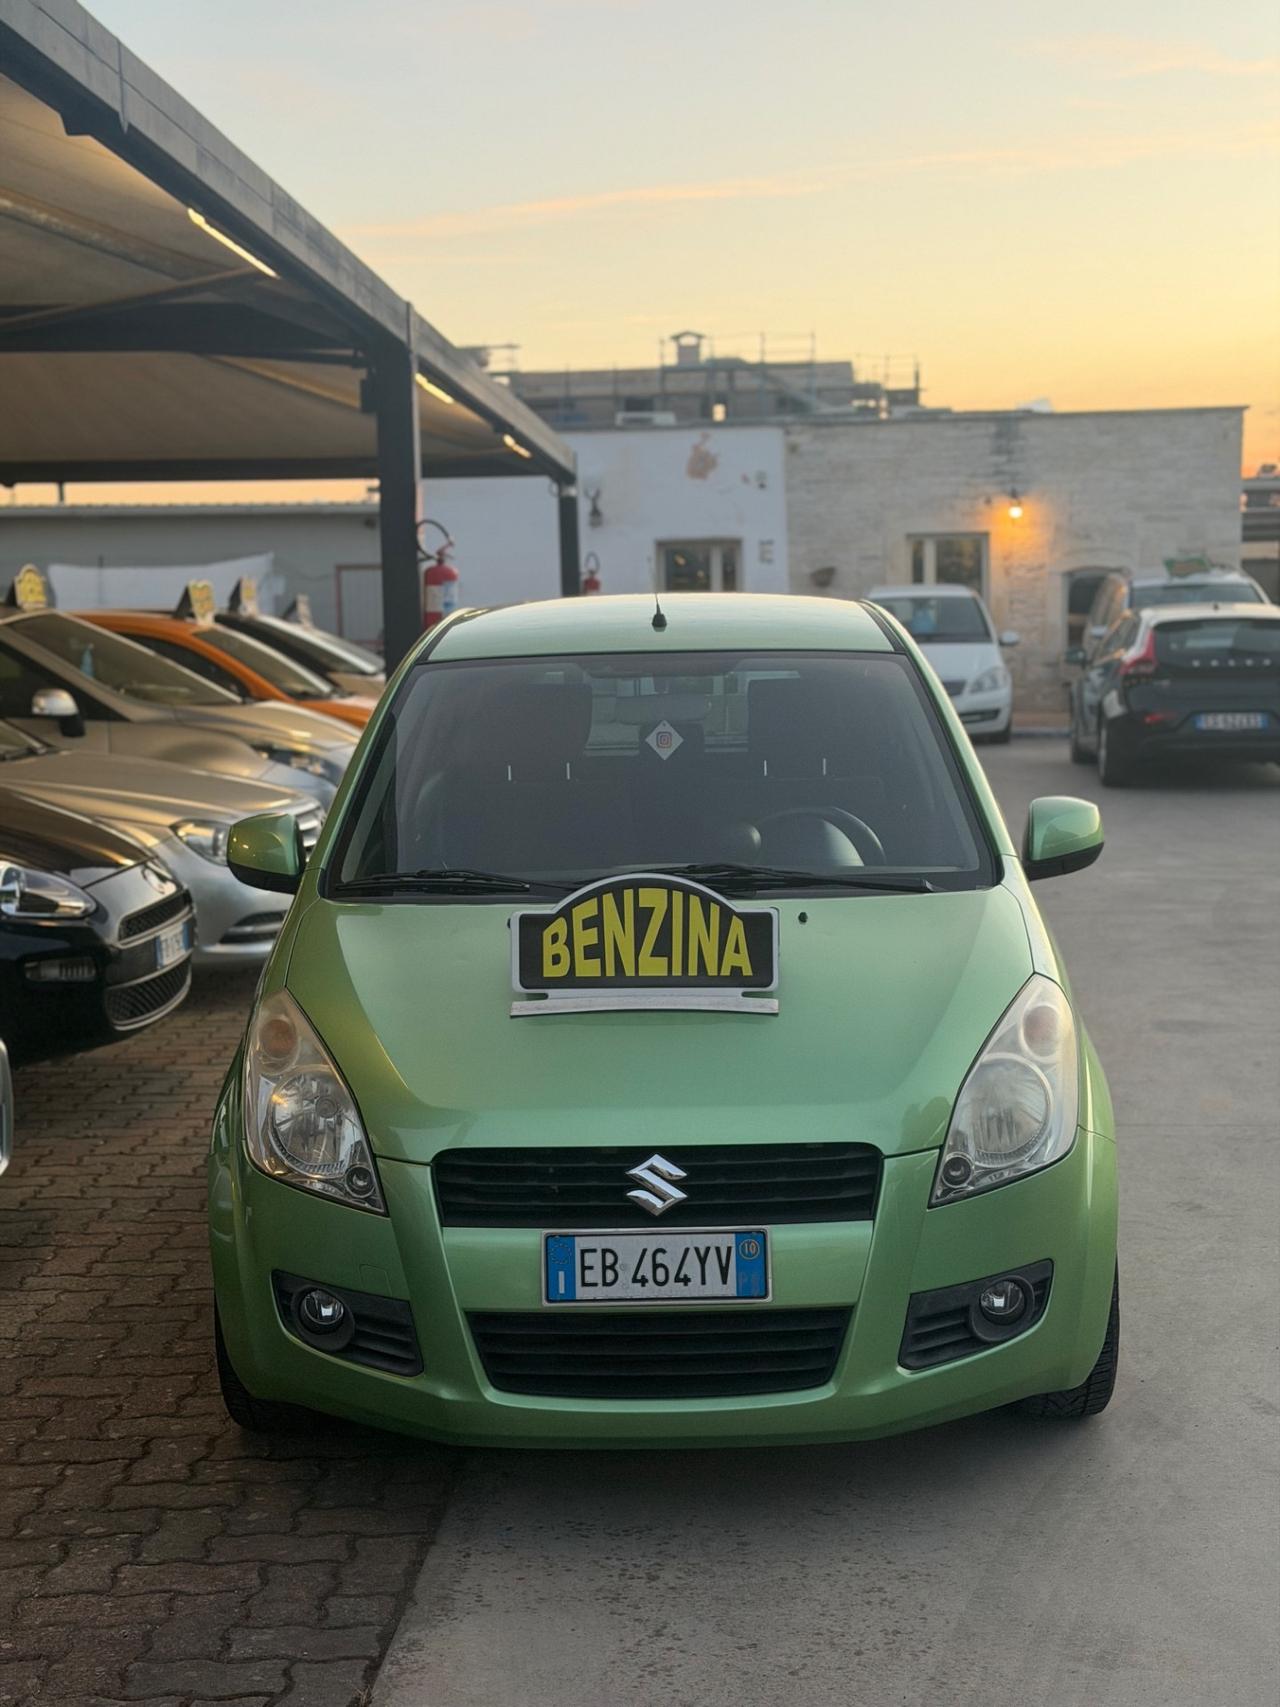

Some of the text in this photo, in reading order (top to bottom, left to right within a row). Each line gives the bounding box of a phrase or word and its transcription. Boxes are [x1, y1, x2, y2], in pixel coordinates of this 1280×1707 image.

[543, 887, 753, 977] BENZINA
[580, 1248, 620, 1288] EB
[631, 1246, 733, 1288] 464YV
